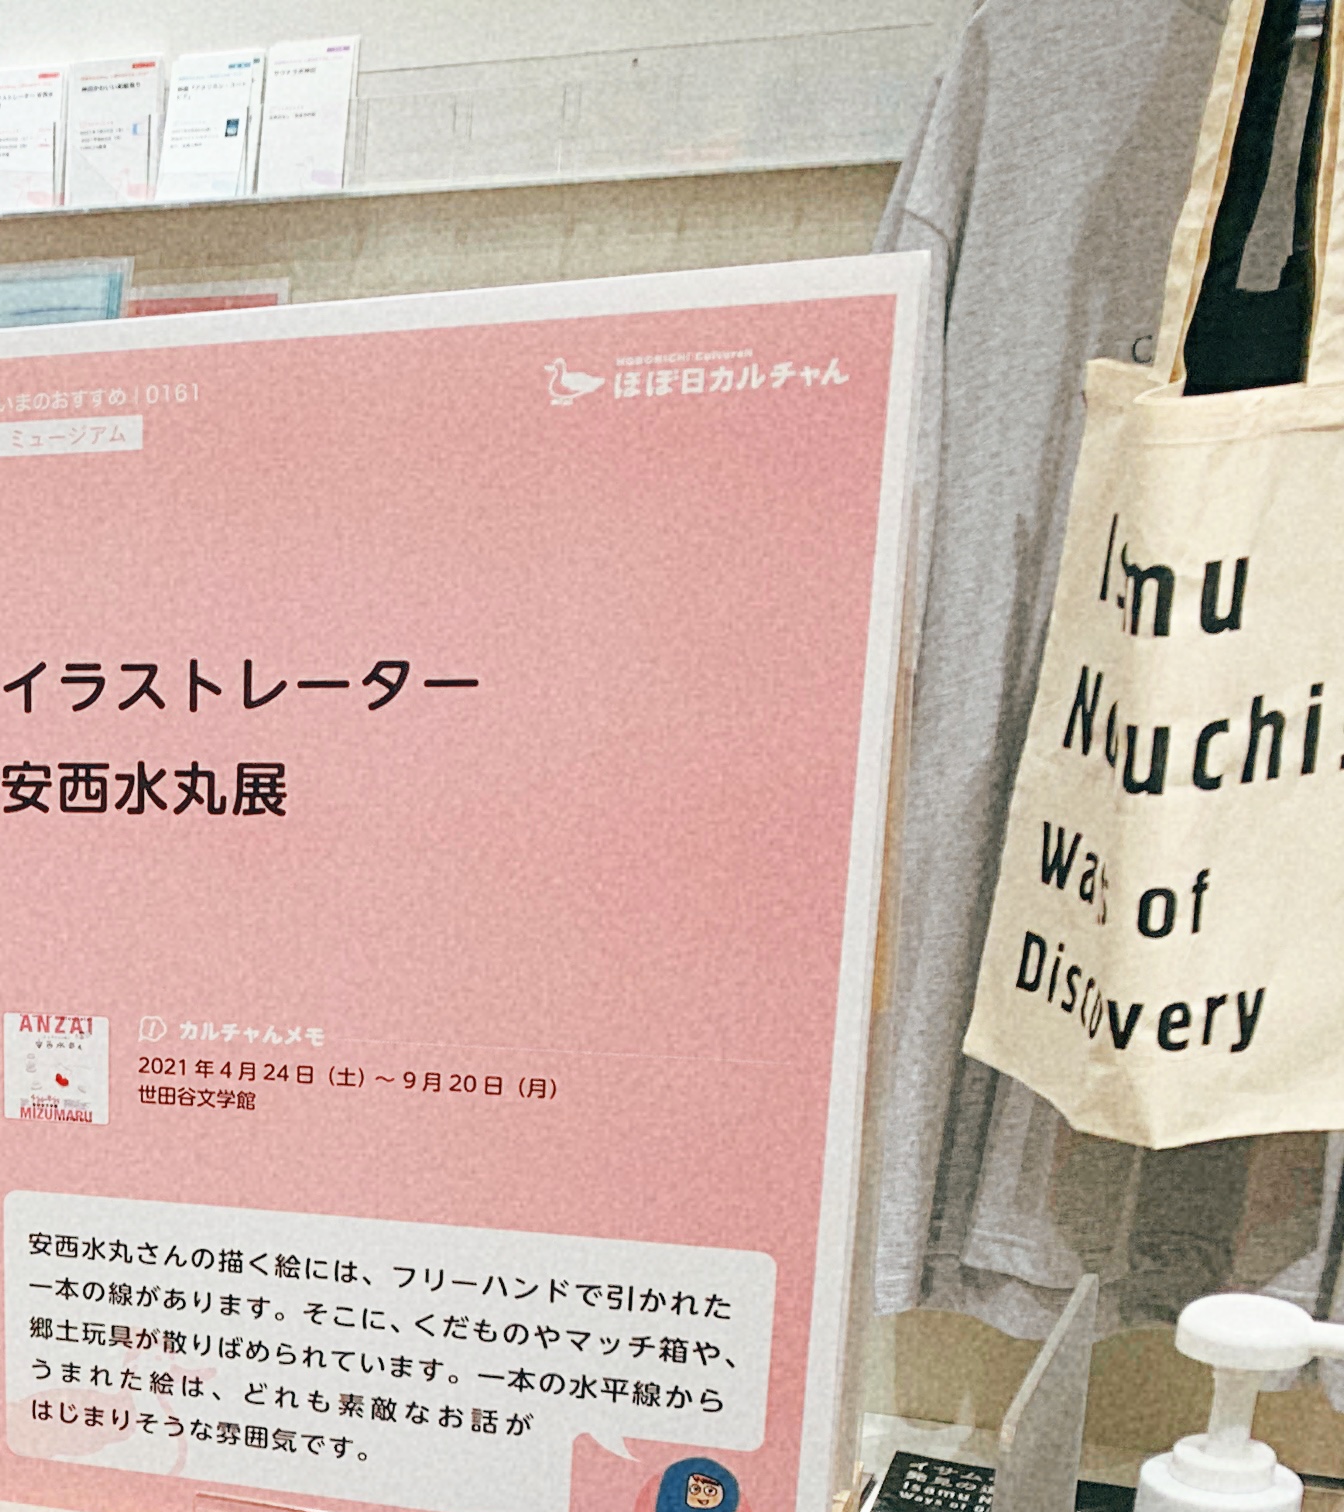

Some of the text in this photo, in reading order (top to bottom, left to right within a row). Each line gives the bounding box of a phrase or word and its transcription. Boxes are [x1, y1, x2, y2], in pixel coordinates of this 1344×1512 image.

[145, 382, 201, 406] 0161
[613, 357, 850, 400] ほぼ日カルチャん
[10, 424, 128, 450] ミュージアム
[2, 657, 481, 714] イラストレーター
[0, 758, 289, 817] 安西水丸展
[1136, 867, 1212, 940] of
[1014, 930, 1267, 1055] Discovery
[18, 1013, 94, 1036] ANZAI
[179, 1019, 326, 1048] カルチャんメモ
[19, 1105, 94, 1124] MIZUMARU
[138, 1083, 257, 1112] 世田谷文学館
[28, 1231, 733, 1320] 安西水丸さんの描く絵には、フリーハンドで引かれた
[29, 1275, 737, 1369] 一本の線があります。そこに、くだものやマッチ箱や、
[28, 1314, 726, 1414] 郷土玩具が散りばめられています。一本の水平線から
[31, 1357, 534, 1437] うまれた絵は、どれも素敵なお話が
[31, 1398, 369, 1463] はじまりそうな雰囲気です。
